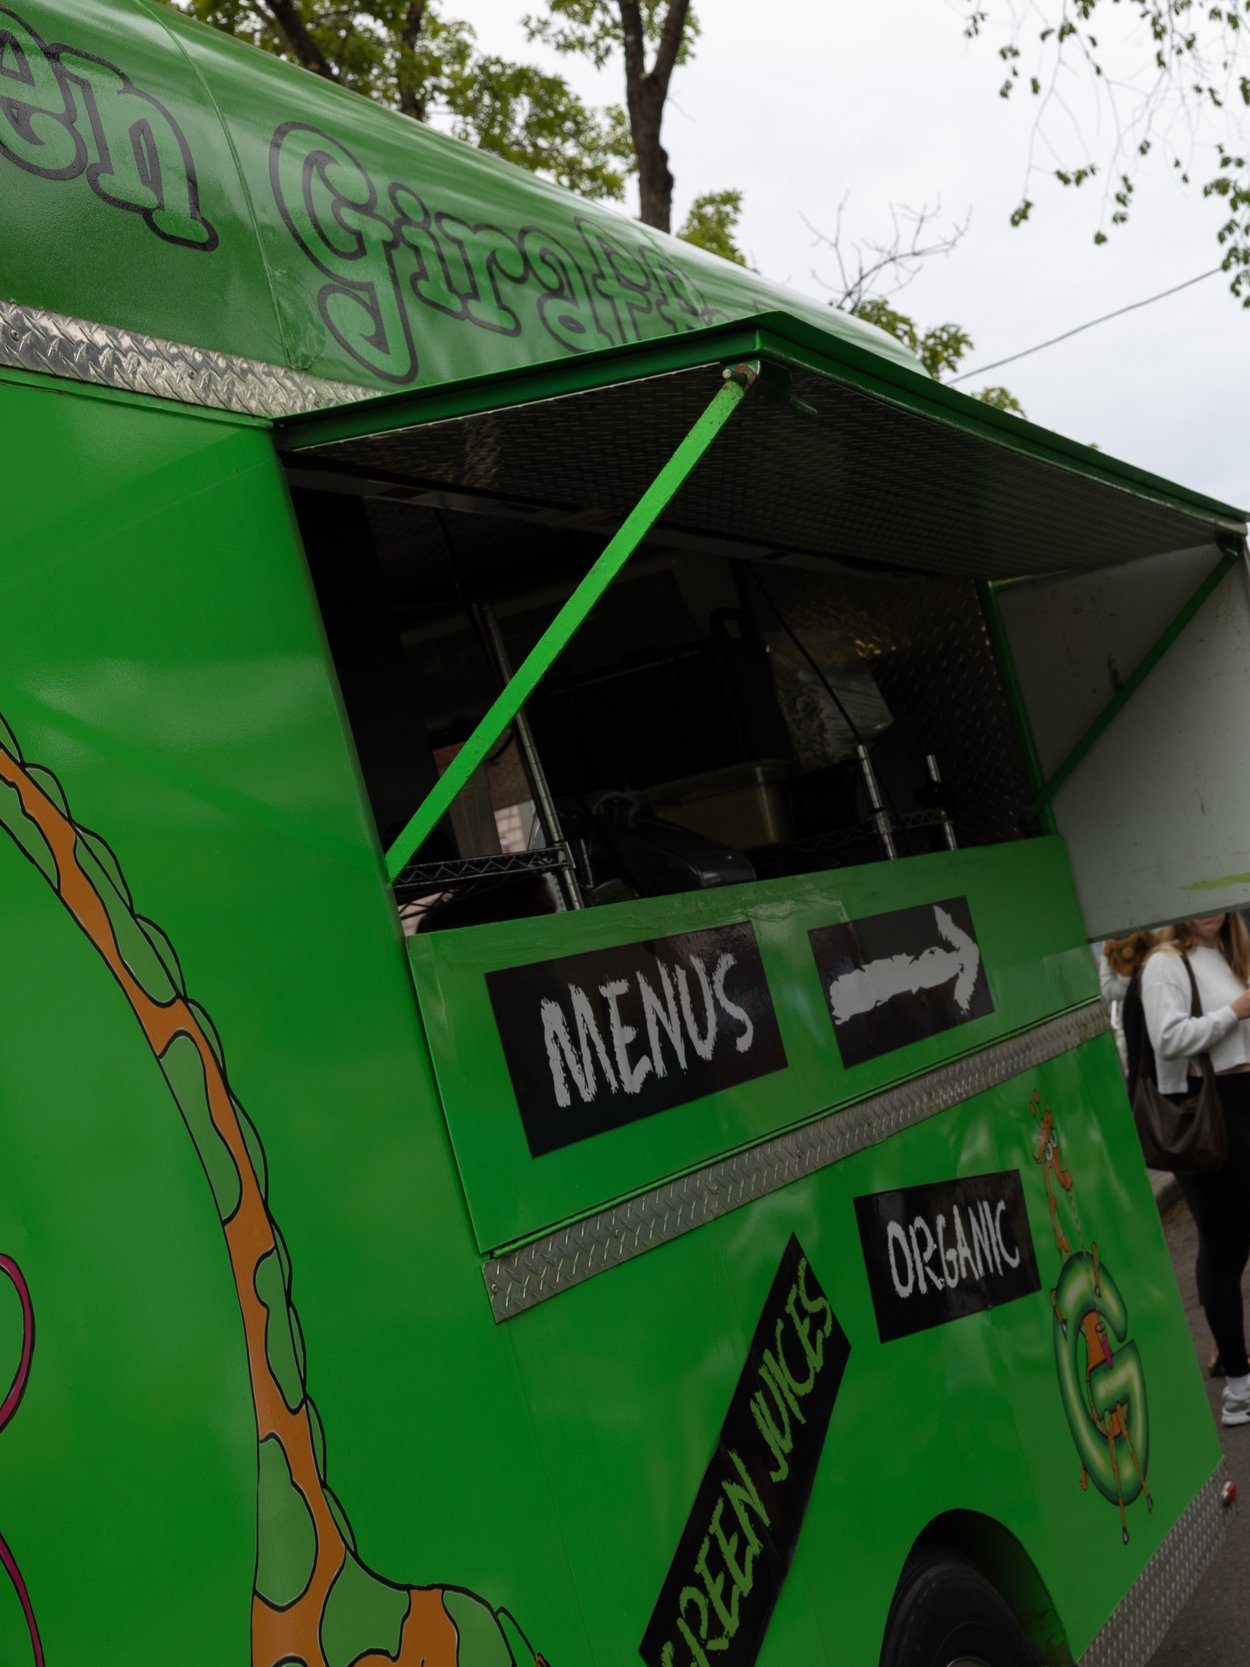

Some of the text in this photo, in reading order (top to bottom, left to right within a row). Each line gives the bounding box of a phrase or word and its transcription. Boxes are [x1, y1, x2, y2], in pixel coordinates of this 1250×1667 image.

[540, 952, 754, 1107] MENUS
[886, 1199, 1021, 1298] ORGANIC
[749, 1257, 833, 1483] JUICES
